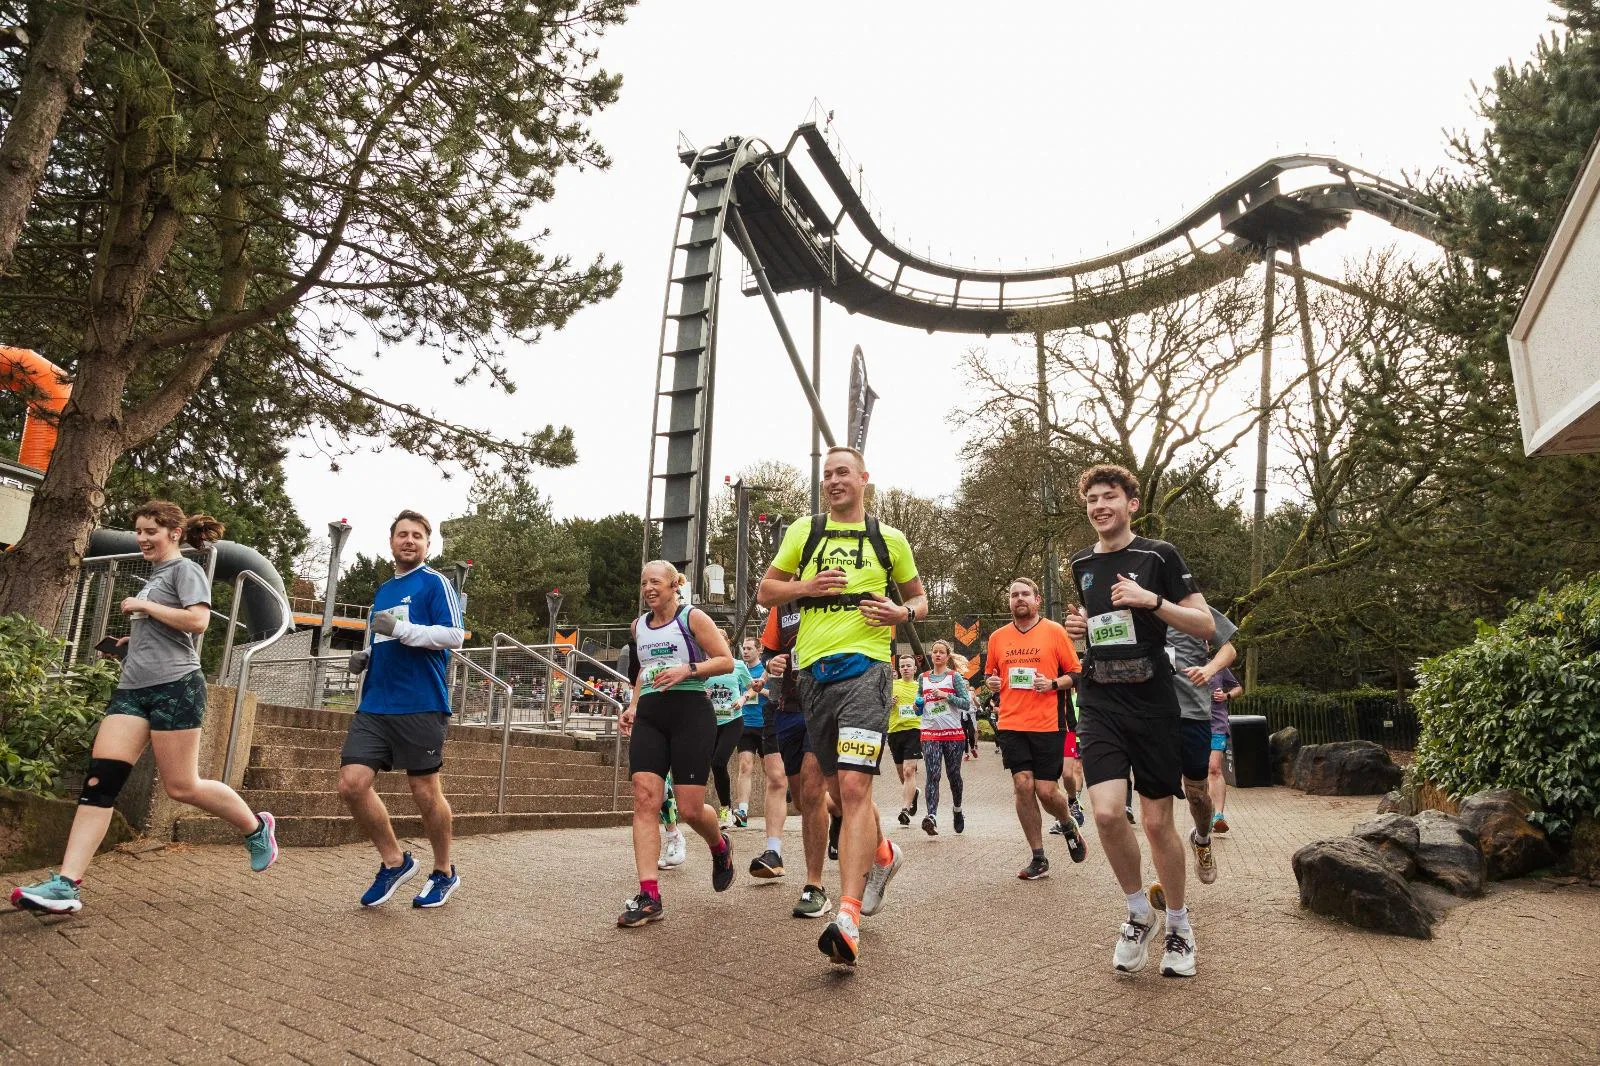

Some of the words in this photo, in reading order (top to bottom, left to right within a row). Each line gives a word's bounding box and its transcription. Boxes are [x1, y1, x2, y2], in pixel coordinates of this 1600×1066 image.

[1095, 625, 1124, 641] 1915
[1005, 647, 1041, 658] SMALLEY
[1013, 675, 1029, 683] 764
